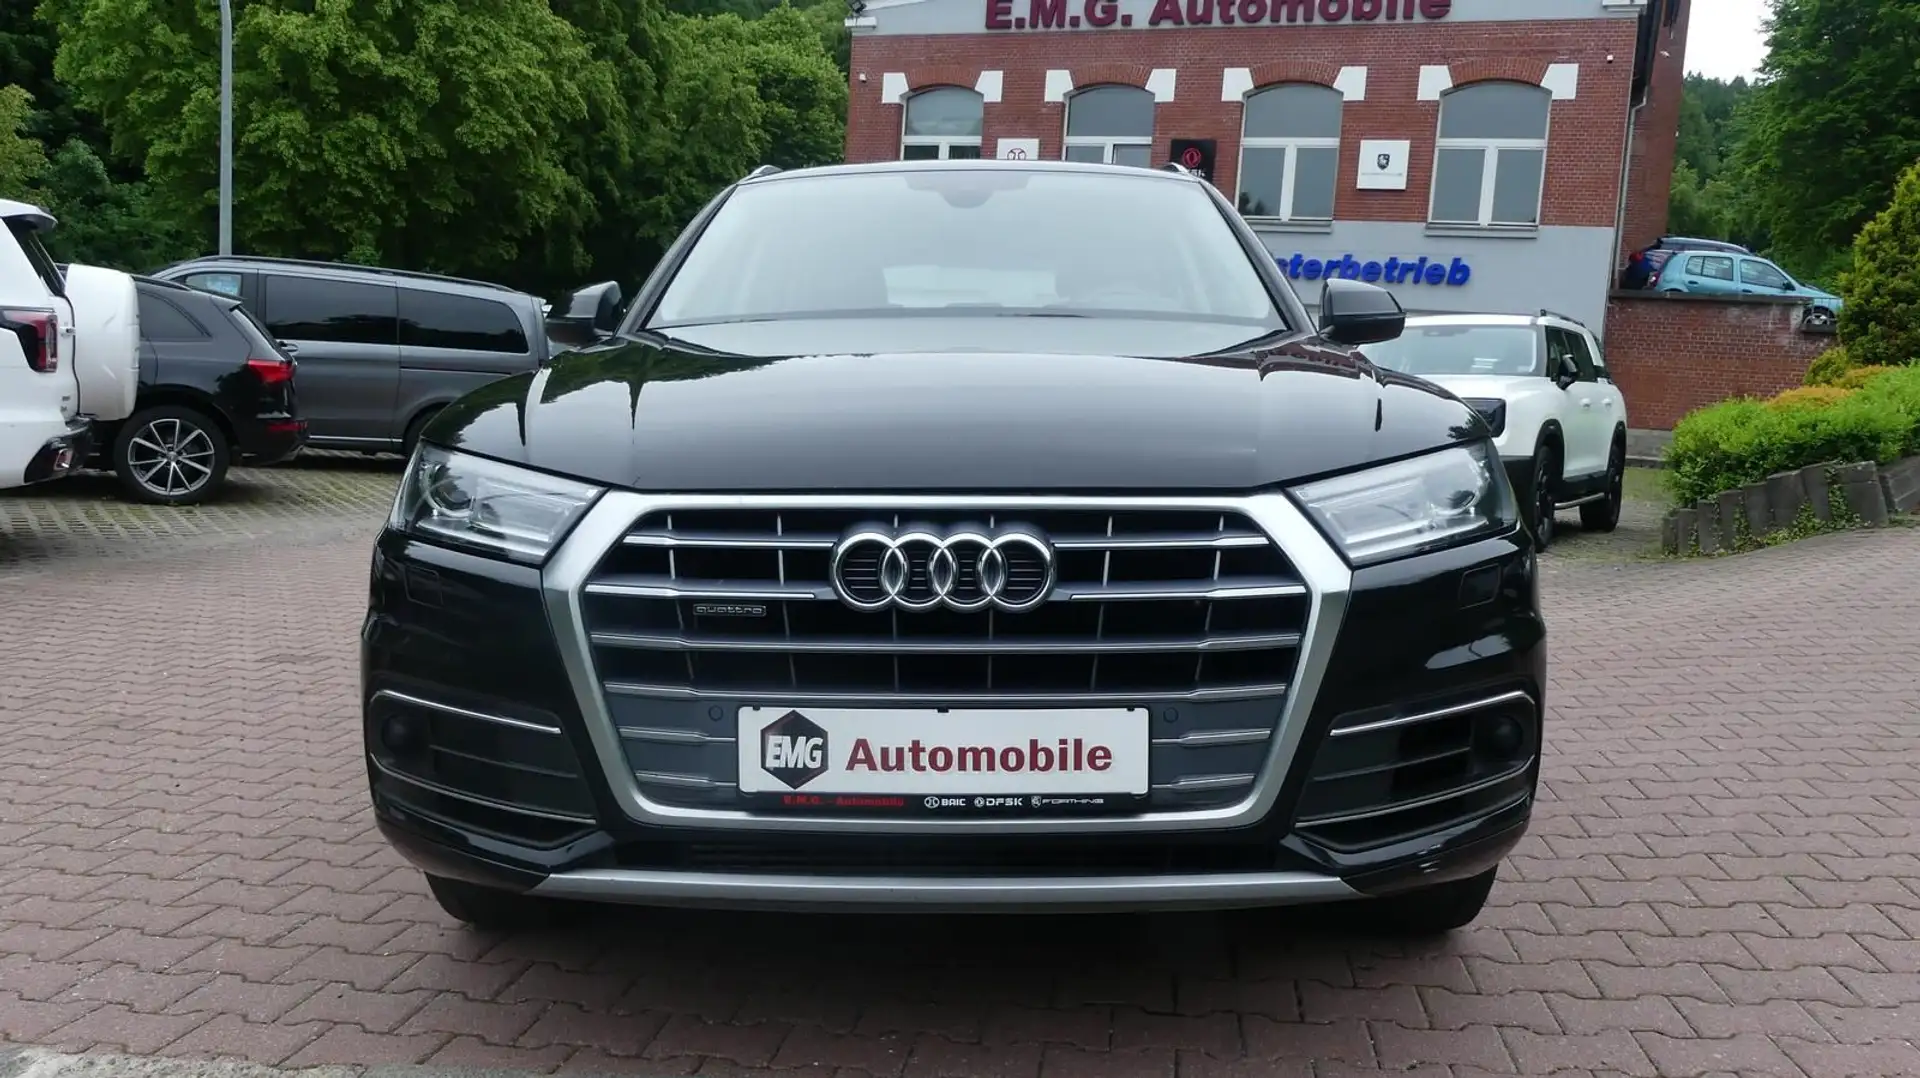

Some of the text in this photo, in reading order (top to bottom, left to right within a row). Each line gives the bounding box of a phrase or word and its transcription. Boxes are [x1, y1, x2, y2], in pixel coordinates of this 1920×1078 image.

[986, 0, 1451, 30] E.M.G. Automobile
[696, 606, 762, 614] quattro
[767, 736, 1113, 772] EMG Automobile
[941, 798, 966, 806] BAIC
[986, 797, 1023, 806] DFSK
